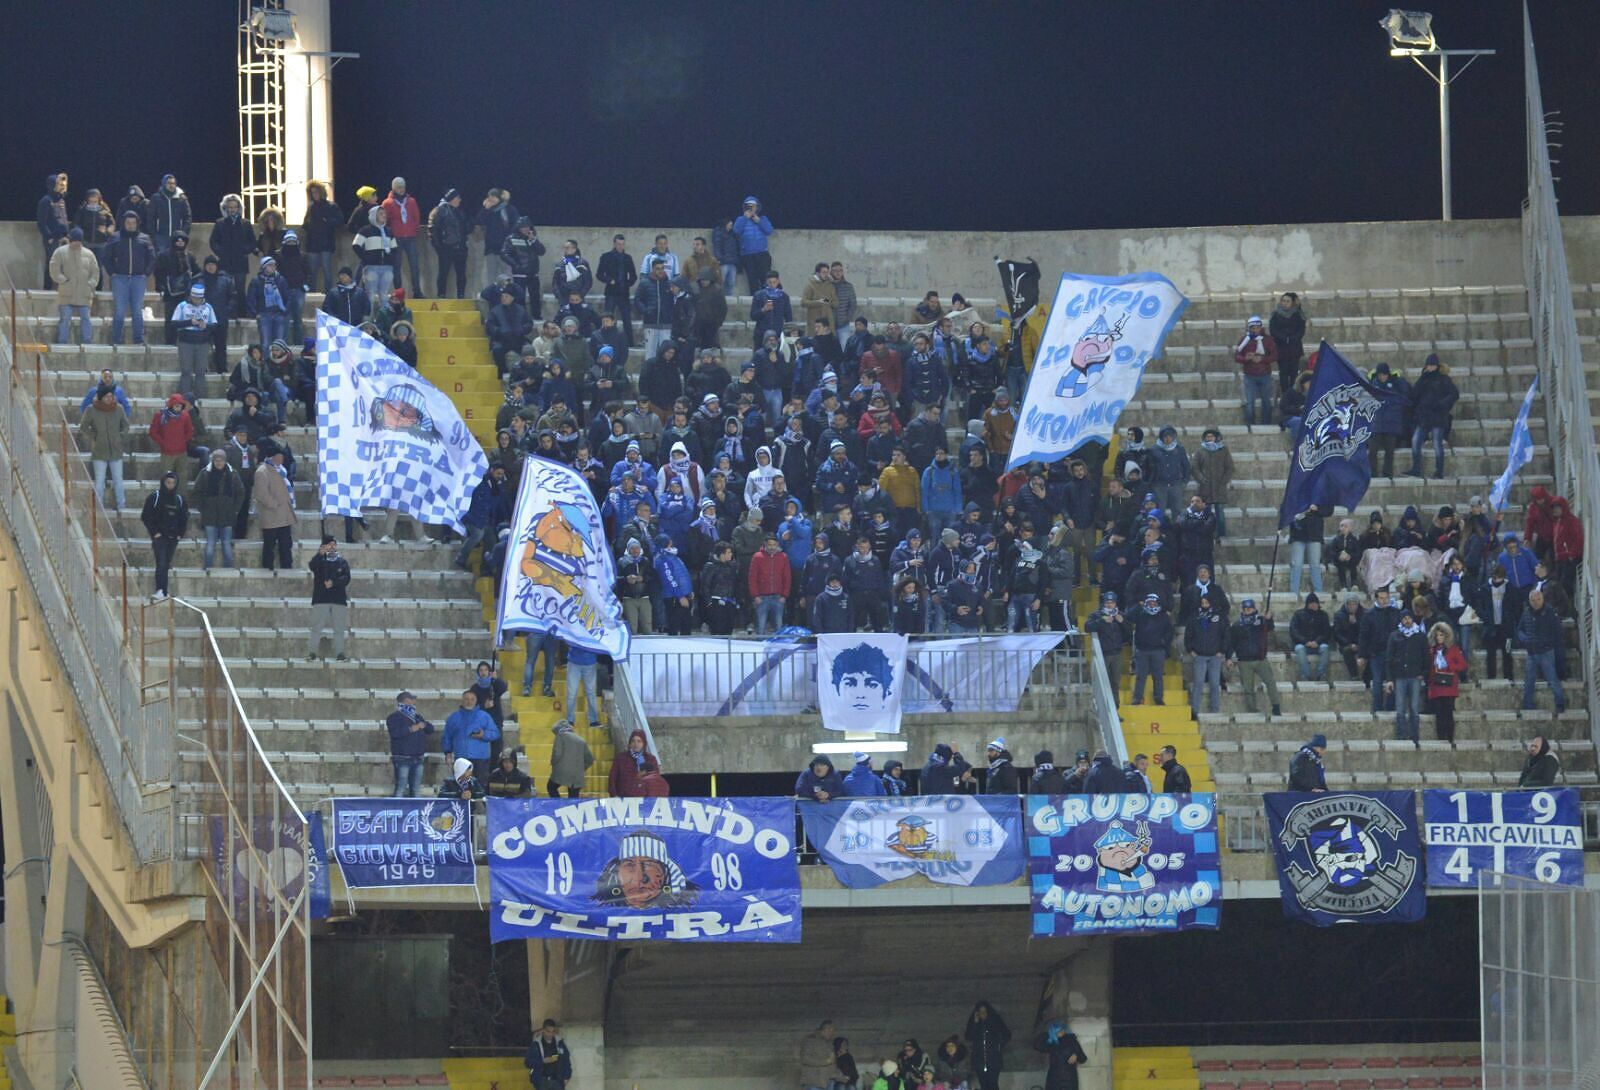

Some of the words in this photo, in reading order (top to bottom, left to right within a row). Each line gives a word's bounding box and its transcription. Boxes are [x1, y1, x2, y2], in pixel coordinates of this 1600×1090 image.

[430, 302, 439, 311] A
[440, 327, 448, 338] B
[447, 355, 455, 365] C
[454, 382, 463, 393] D
[352, 395, 366, 428] 19
[465, 409, 473, 419] E
[1150, 723, 1160, 734] R
[1033, 794, 1211, 835] GRUPPO
[1303, 801, 1371, 822] MANIERE
[339, 810, 420, 834] BEATA
[492, 797, 790, 859] COMMANDO
[1430, 825, 1577, 846] FRANCAVILLA
[379, 864, 435, 880] 1946
[1055, 854, 1094, 872] 20
[1148, 853, 1185, 870] 05
[545, 852, 573, 895] 19
[711, 852, 743, 891] 98
[1041, 881, 1213, 918] AUTONOMO
[500, 895, 793, 939] ULTRÀ
[1074, 918, 1176, 929] FRANCAVILLA
